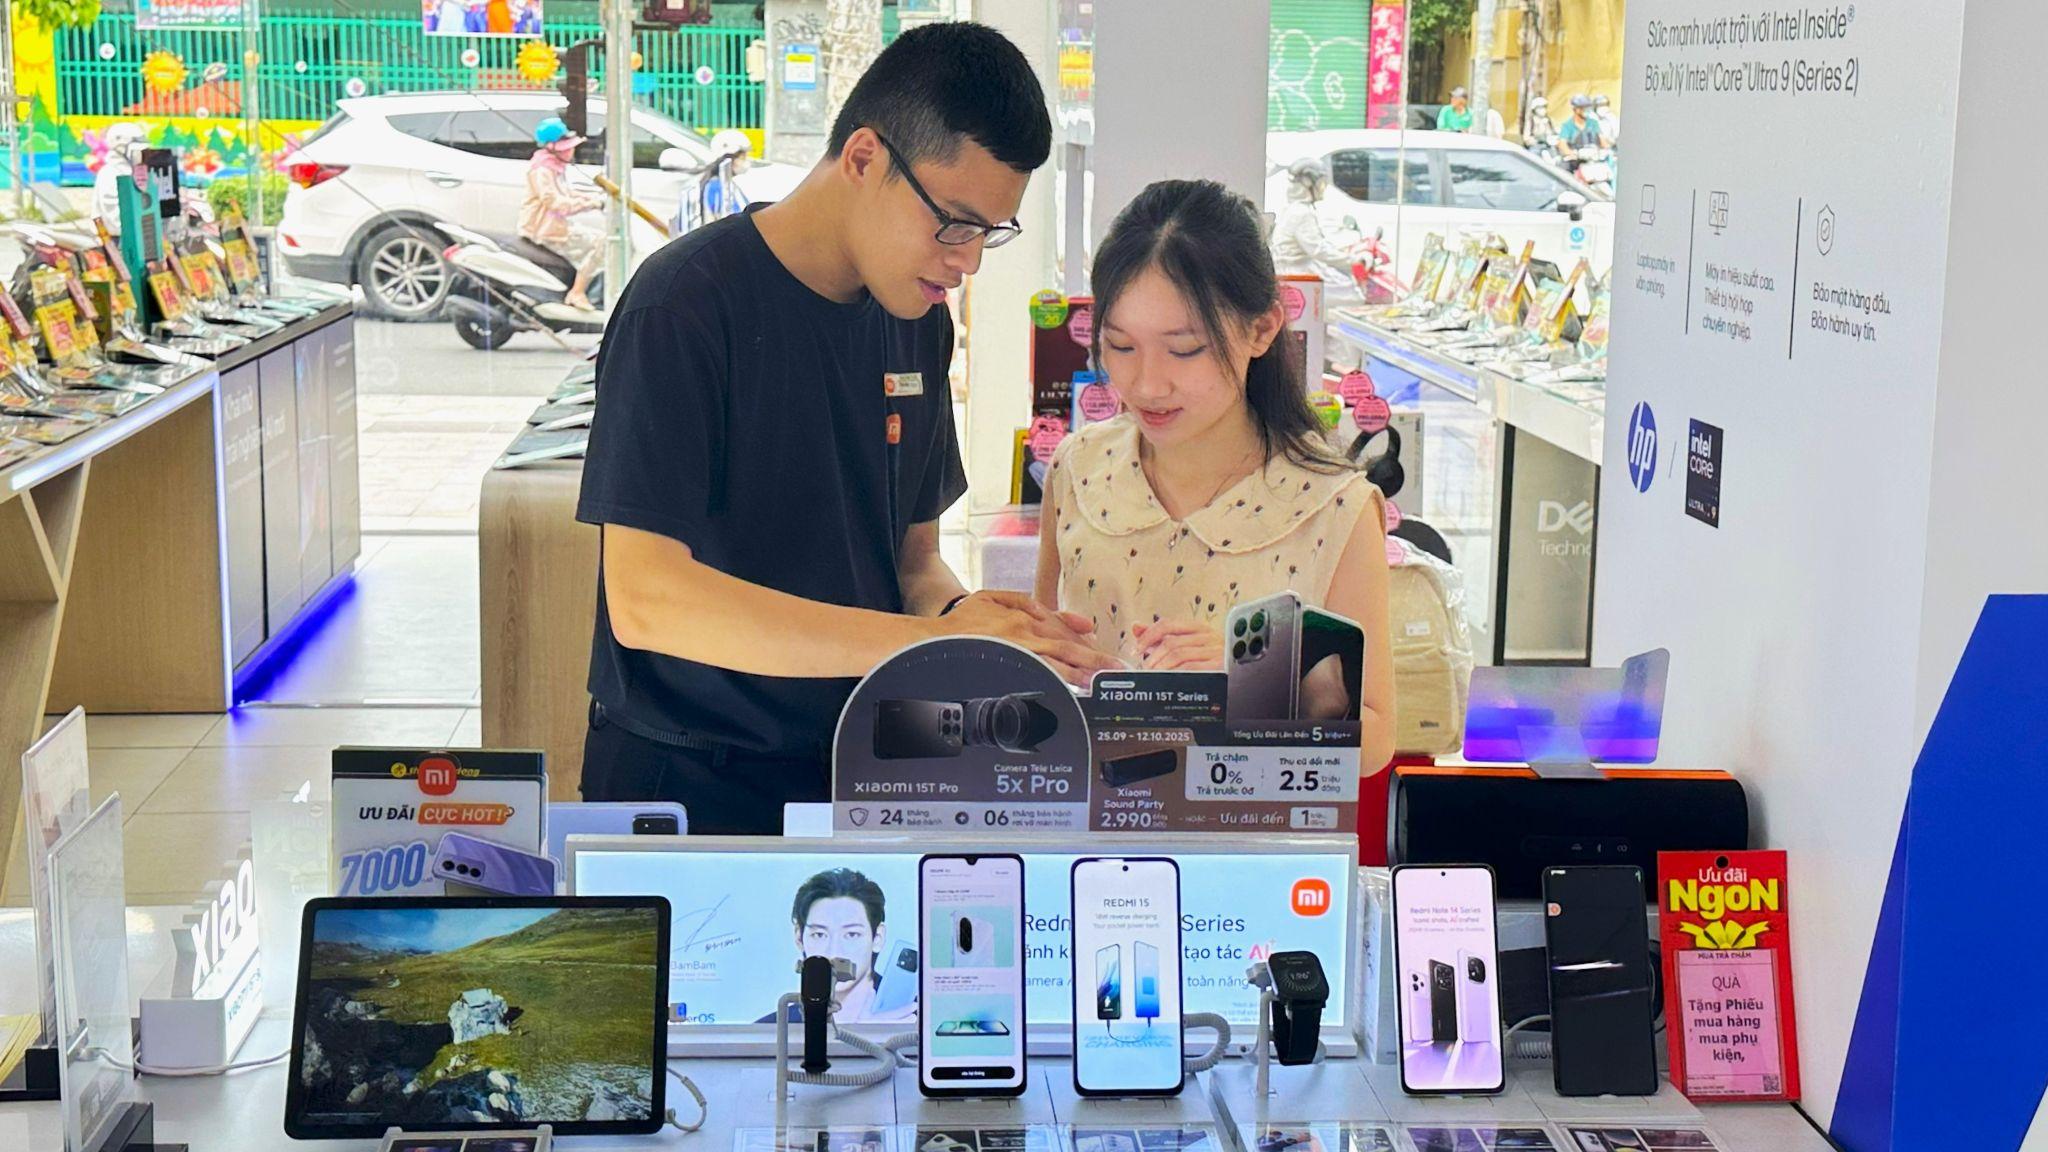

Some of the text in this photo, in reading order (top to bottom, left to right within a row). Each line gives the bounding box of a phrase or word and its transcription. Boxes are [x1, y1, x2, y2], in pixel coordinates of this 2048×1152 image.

[1647, 18, 1668, 47] Sức
[1669, 18, 1699, 51] mạnh
[1702, 18, 1727, 50] vượt
[1729, 14, 1749, 48] trội
[1752, 12, 1770, 42] với
[1773, 9, 1801, 41] Intel
[1645, 64, 1659, 96] Bộ
[1675, 63, 1685, 97] lý
[1749, 62, 1778, 91] Ultra
[1781, 61, 1789, 91] 9
[1793, 59, 1842, 96] (Series
[1845, 58, 1858, 96] 2)
[1813, 282, 1829, 302] Bảo
[1831, 288, 1847, 308] mật
[1848, 289, 1871, 314] hàng
[1811, 310, 1827, 331] Bảo
[1828, 314, 1849, 335] hành
[1851, 322, 1862, 342] uy
[1627, 401, 1656, 492] hp
[1691, 428, 1713, 458] intel
[1537, 500, 1594, 535] DE
[1156, 692, 1174, 701] 15T
[1177, 692, 1209, 702] Series
[1097, 732, 1190, 741] 25.09 12.10.2025
[1312, 727, 1323, 741] 5
[1222, 752, 1248, 763] chậm
[1280, 757, 1294, 765] Thu
[1296, 757, 1307, 765] cũ
[994, 764, 1073, 773] Camera Tele Leica
[1210, 762, 1243, 785] 0%
[916, 783, 936, 793] 15T
[939, 783, 959, 793] Pro
[996, 774, 1069, 794] 5x Pro
[1279, 770, 1319, 791] 2.5
[1118, 788, 1152, 797] Xiaomi
[358, 804, 415, 821] ƯU ĐÃI
[1104, 800, 1164, 810] Sound Party
[424, 807, 458, 824] CỰC
[880, 809, 903, 825] 24
[984, 809, 1009, 826] 06
[1101, 812, 1152, 827] 2.990
[1220, 811, 1285, 824] Ưu đãi đến
[1301, 810, 1309, 829] 1
[340, 842, 427, 896] 7000
[1699, 867, 1747, 882] Ưu đãi
[1104, 898, 1150, 907] REDMI 15
[1669, 878, 1779, 920] NgoN
[1181, 914, 1245, 932] Series
[1184, 944, 1210, 962] tạo
[1217, 944, 1242, 959] tác
[1025, 975, 1250, 989] amera toàn năng
[1688, 997, 1764, 1013] Tặng Phiếu
[1694, 1015, 1760, 1029] mua hàng
[1699, 1032, 1758, 1046] mua phụ
[1713, 1047, 1745, 1063] kiện,
